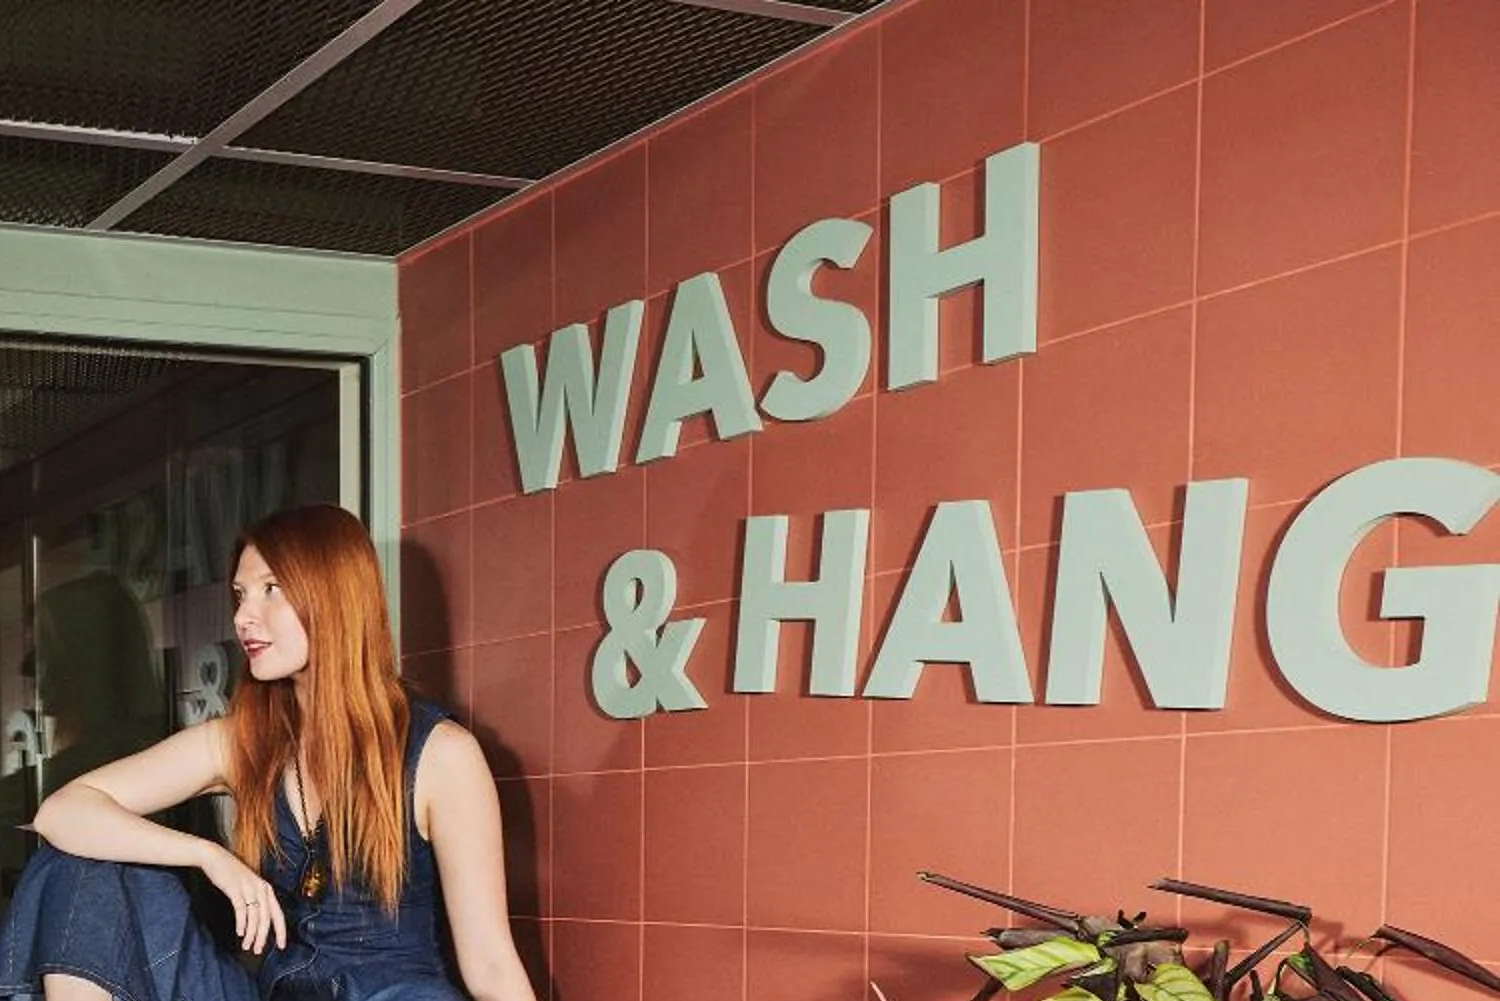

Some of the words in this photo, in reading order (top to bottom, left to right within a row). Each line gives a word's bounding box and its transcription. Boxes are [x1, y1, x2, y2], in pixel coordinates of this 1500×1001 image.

[500, 142, 1040, 494] WASH
[592, 549, 708, 719] &
[734, 457, 1500, 722] HANG
